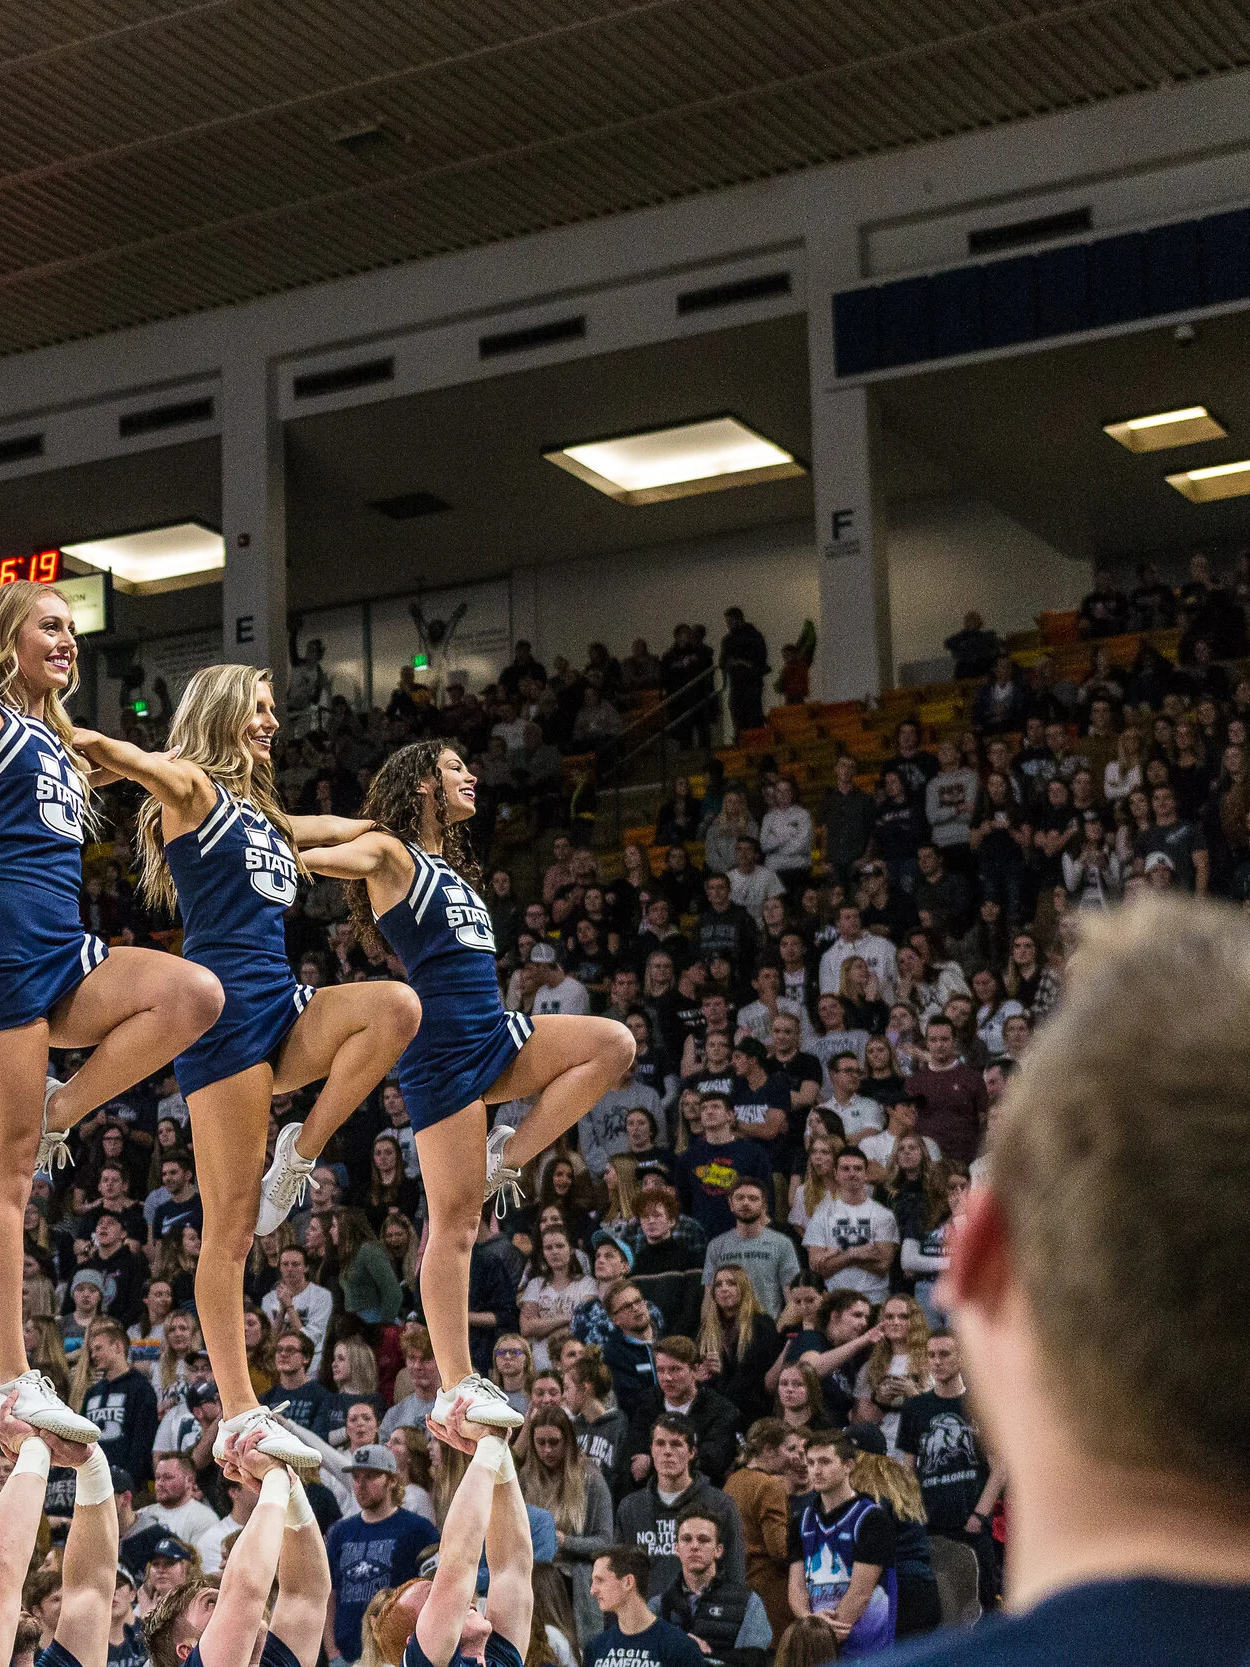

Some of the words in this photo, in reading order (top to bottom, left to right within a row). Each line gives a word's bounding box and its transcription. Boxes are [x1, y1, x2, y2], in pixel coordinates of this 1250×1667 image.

[832, 509, 853, 540] F
[236, 616, 253, 643] E
[245, 848, 298, 884] STATE
[832, 1225, 872, 1237] STATE
[607, 1647, 650, 1659] AGGIE
